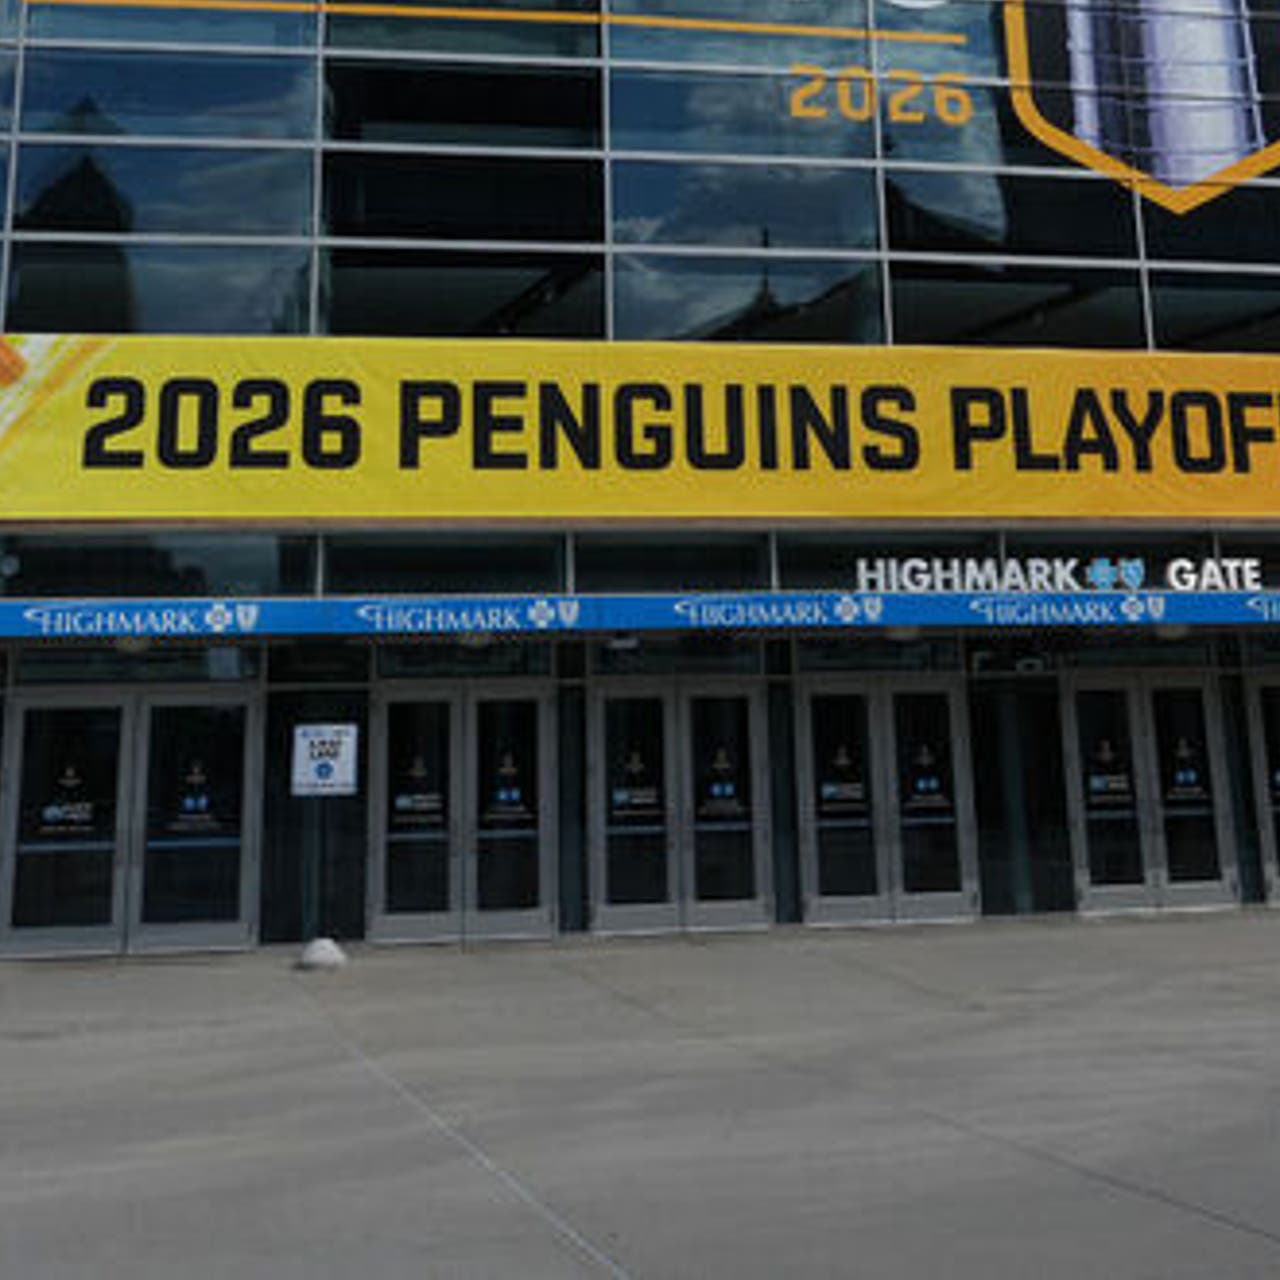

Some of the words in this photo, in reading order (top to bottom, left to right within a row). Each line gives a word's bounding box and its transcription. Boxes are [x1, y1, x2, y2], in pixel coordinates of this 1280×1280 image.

[790, 63, 975, 125] 2026
[81, 377, 362, 470] 2026
[398, 379, 921, 472] PENGUINS
[856, 558, 1081, 592] HIGHMARK
[1166, 558, 1262, 591] GATE
[35, 607, 200, 634] HIGHMARK
[368, 605, 521, 631] HIGHMARK
[979, 597, 1116, 623] HIGHMARK
